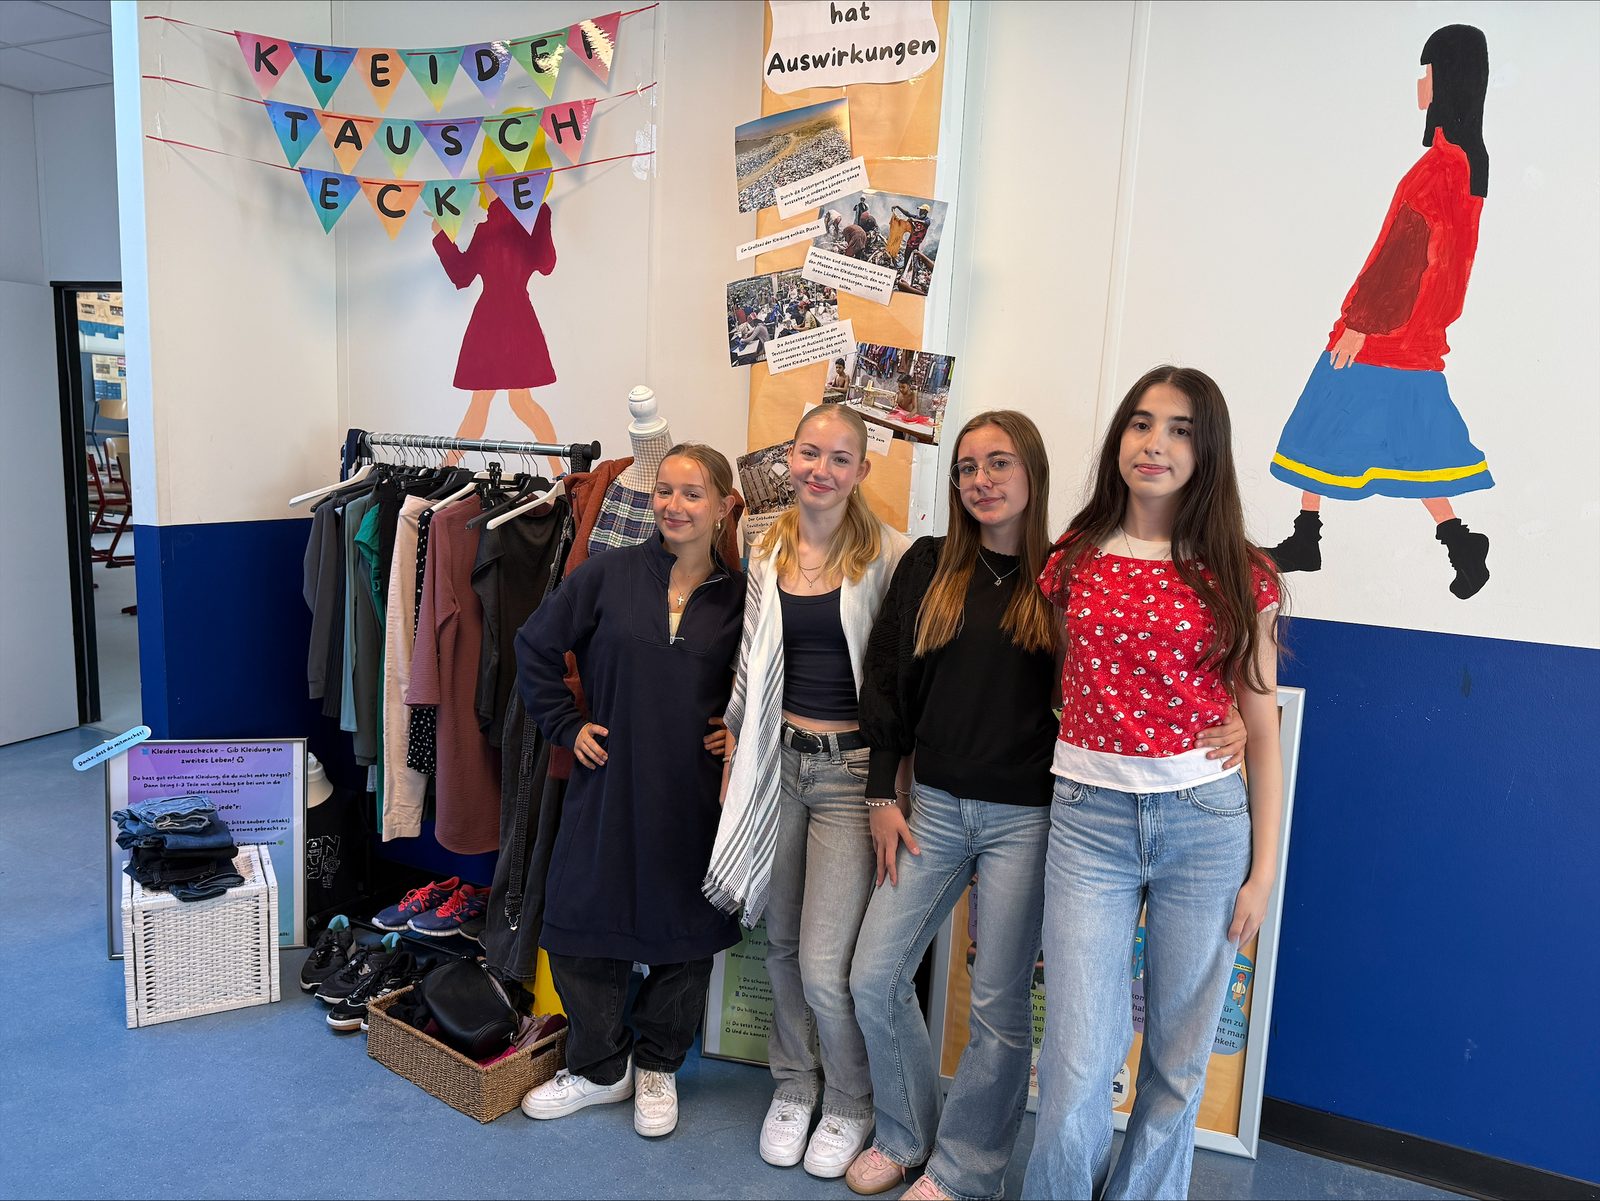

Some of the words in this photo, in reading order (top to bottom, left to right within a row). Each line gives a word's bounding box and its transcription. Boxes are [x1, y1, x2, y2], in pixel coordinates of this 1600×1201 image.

[830, 2, 870, 24] hat
[767, 39, 935, 76] Auswirkungen
[284, 107, 582, 156] TAUSCH
[320, 176, 534, 218] ECKE
[1227, 1030, 1245, 1039] man
